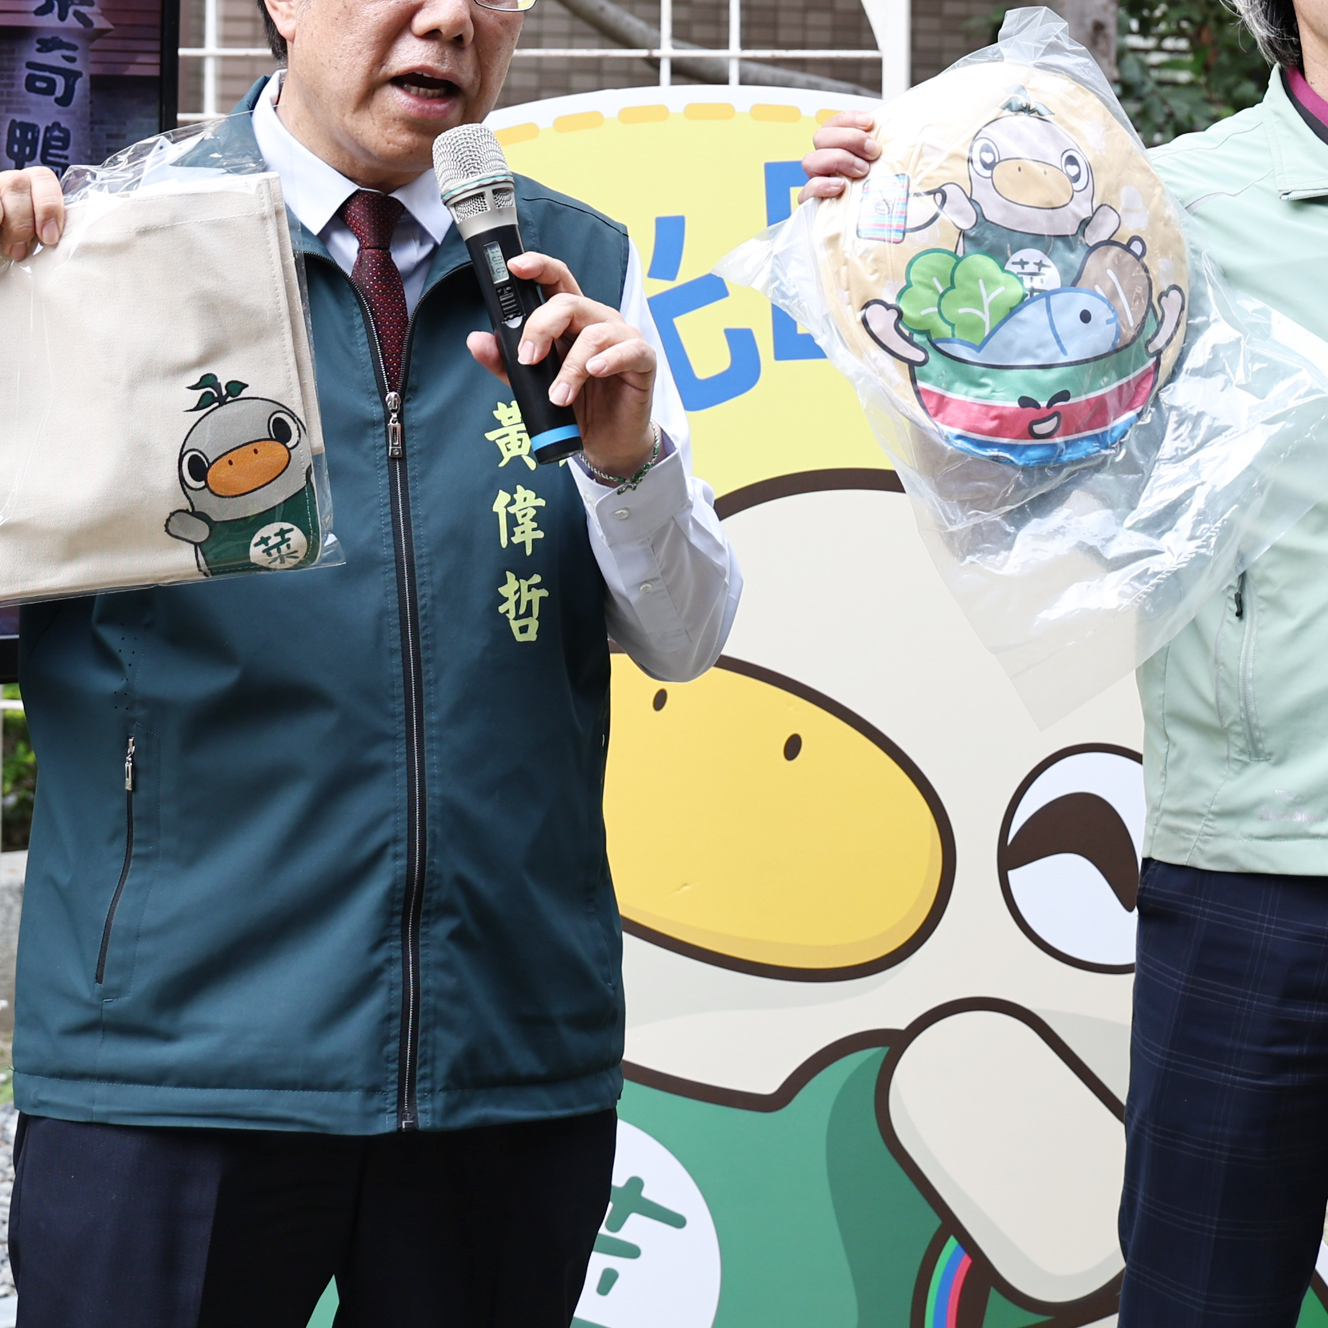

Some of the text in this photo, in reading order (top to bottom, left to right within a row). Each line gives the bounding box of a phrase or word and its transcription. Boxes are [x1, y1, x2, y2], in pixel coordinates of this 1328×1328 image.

[253, 527, 299, 565] 菜
[484, 400, 549, 642] 黃偉哲
